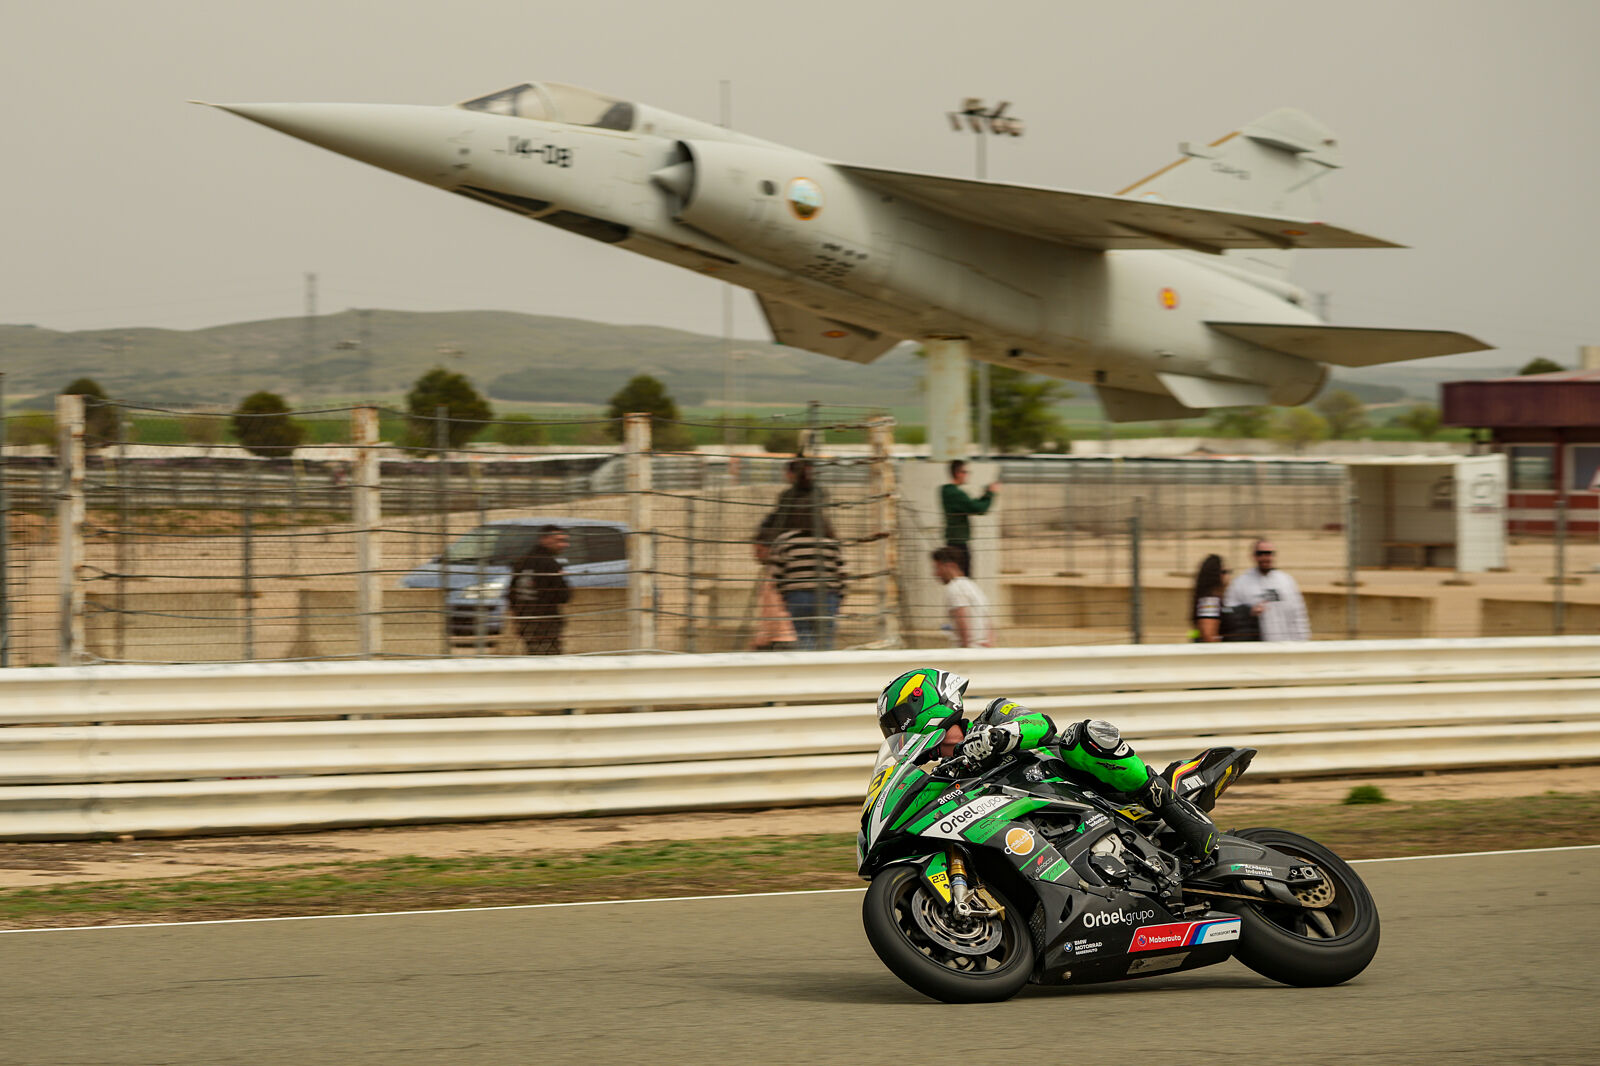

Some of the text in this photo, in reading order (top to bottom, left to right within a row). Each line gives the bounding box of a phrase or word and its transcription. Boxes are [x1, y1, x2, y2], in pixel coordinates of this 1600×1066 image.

[937, 789, 964, 806] arena
[931, 873, 947, 884] 23
[1148, 934, 1182, 944] Maberauto
[1074, 941, 1103, 951] MOTORRAD
